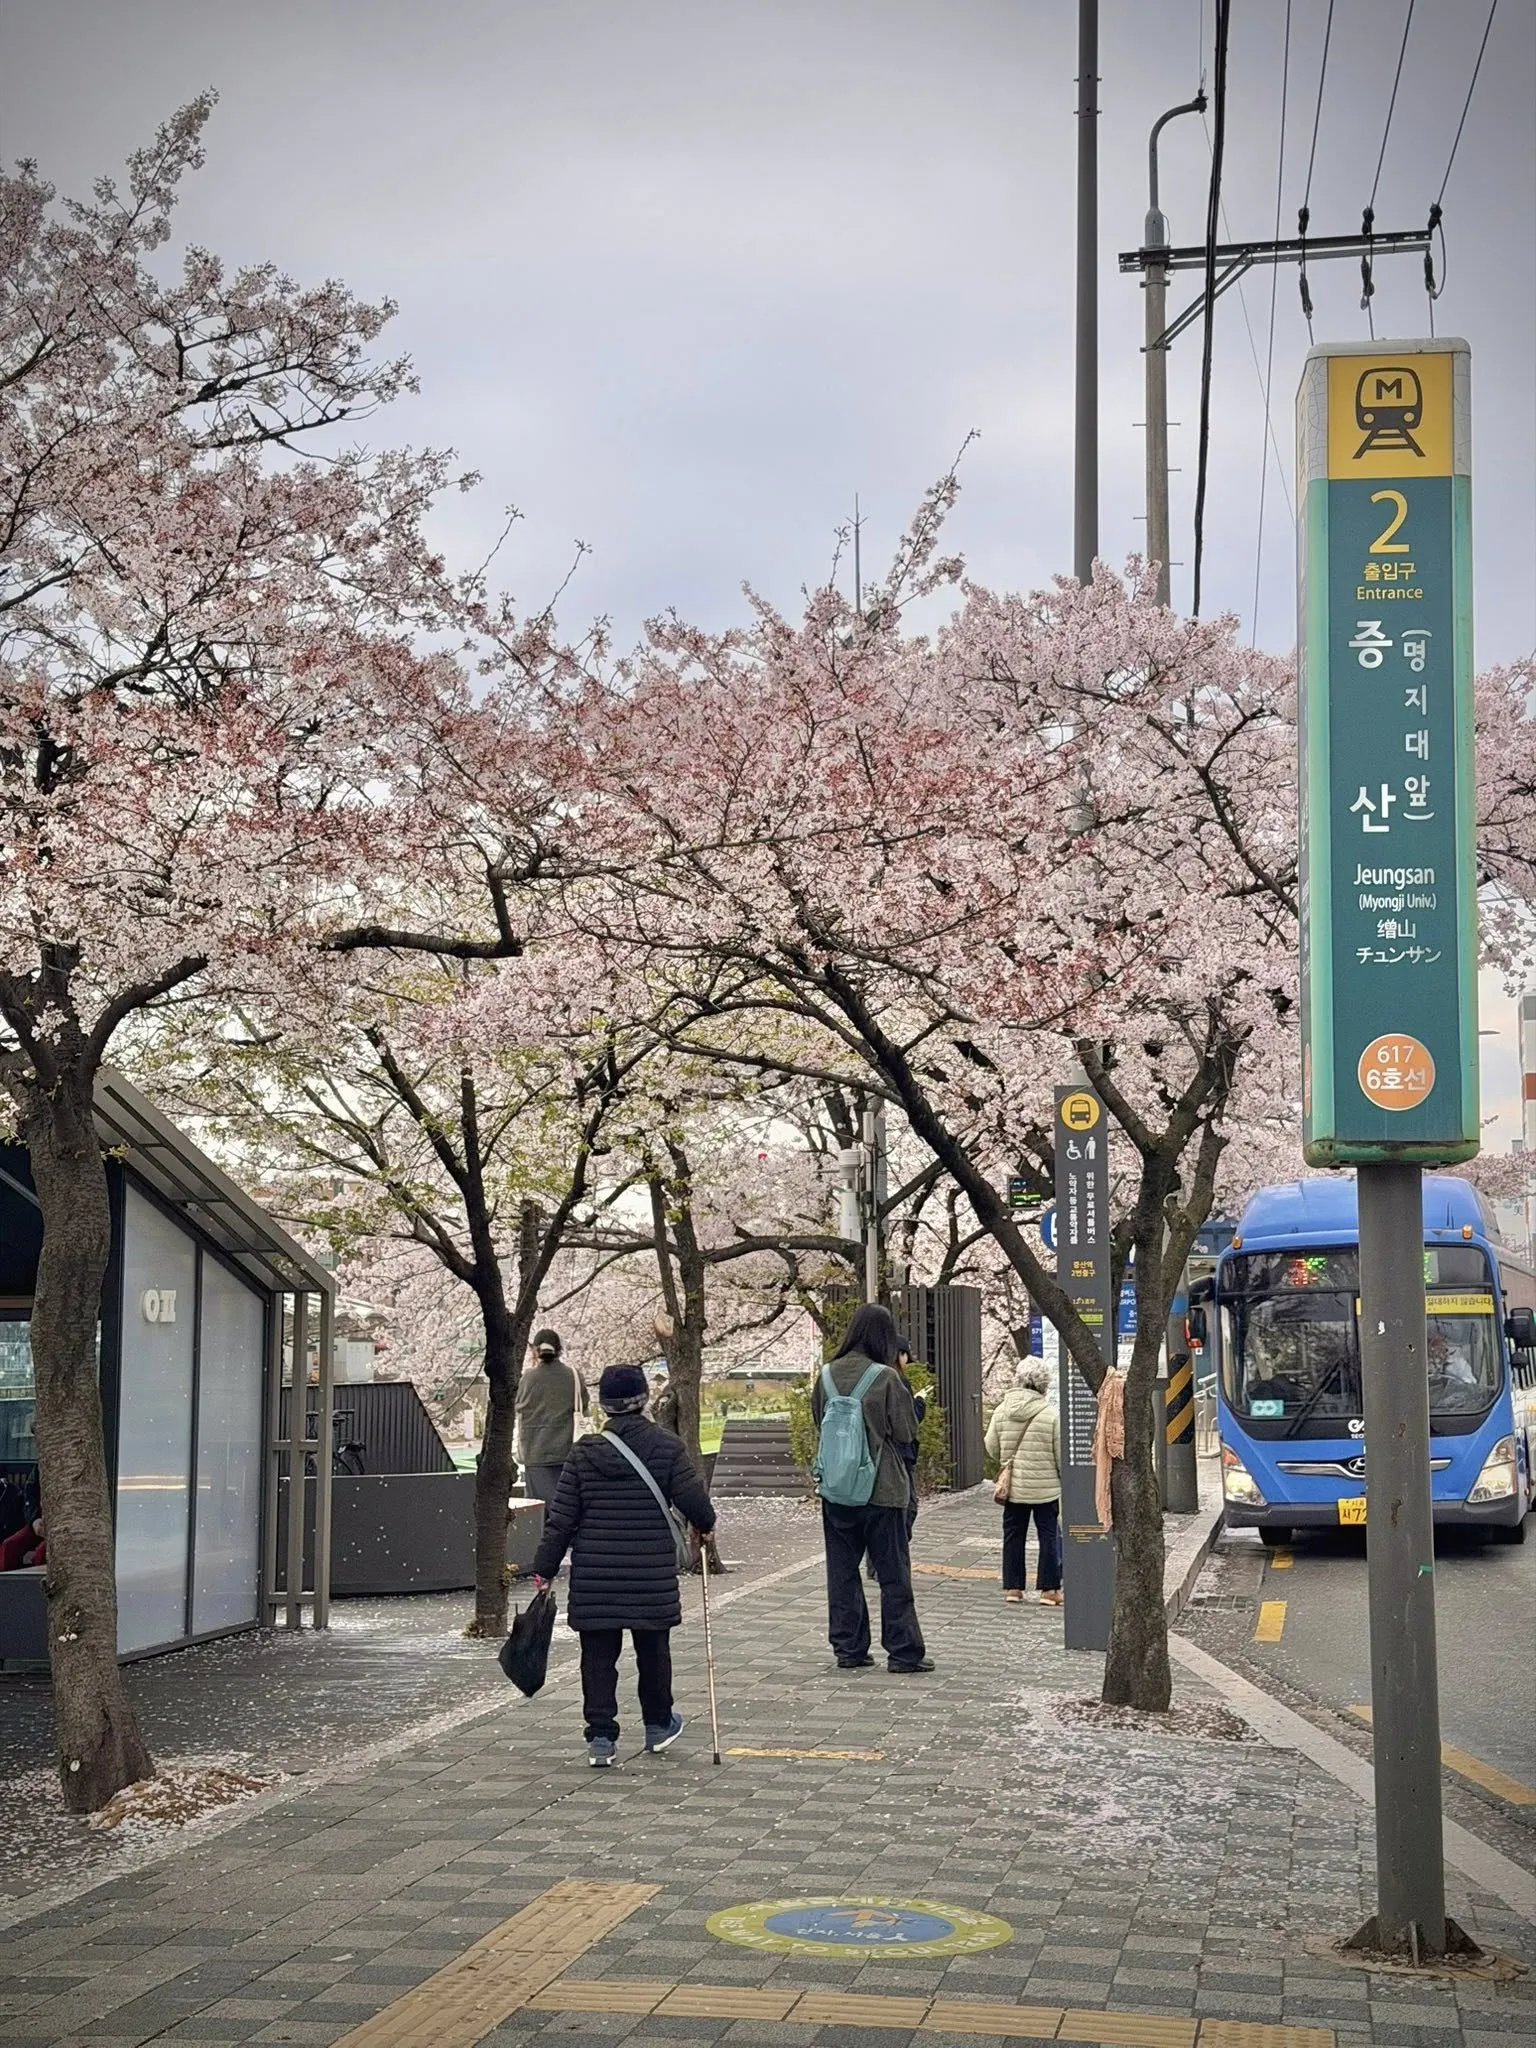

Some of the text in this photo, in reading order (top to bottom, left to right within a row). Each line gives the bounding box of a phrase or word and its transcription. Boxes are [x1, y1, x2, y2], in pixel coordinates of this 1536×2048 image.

[1369, 489, 1410, 554] 2
[1363, 562, 1417, 581] 출입구
[1356, 586, 1424, 600] Entrance
[1353, 863, 1435, 891] Jeungsan
[1358, 892, 1437, 912] (Myongji Univ.)
[1355, 946, 1442, 964] チュンサン
[1376, 1045, 1415, 1064] 617
[1365, 1068, 1427, 1091] 6호선
[727, 1928, 783, 1945] WAY
[790, 1943, 829, 1953] TO
